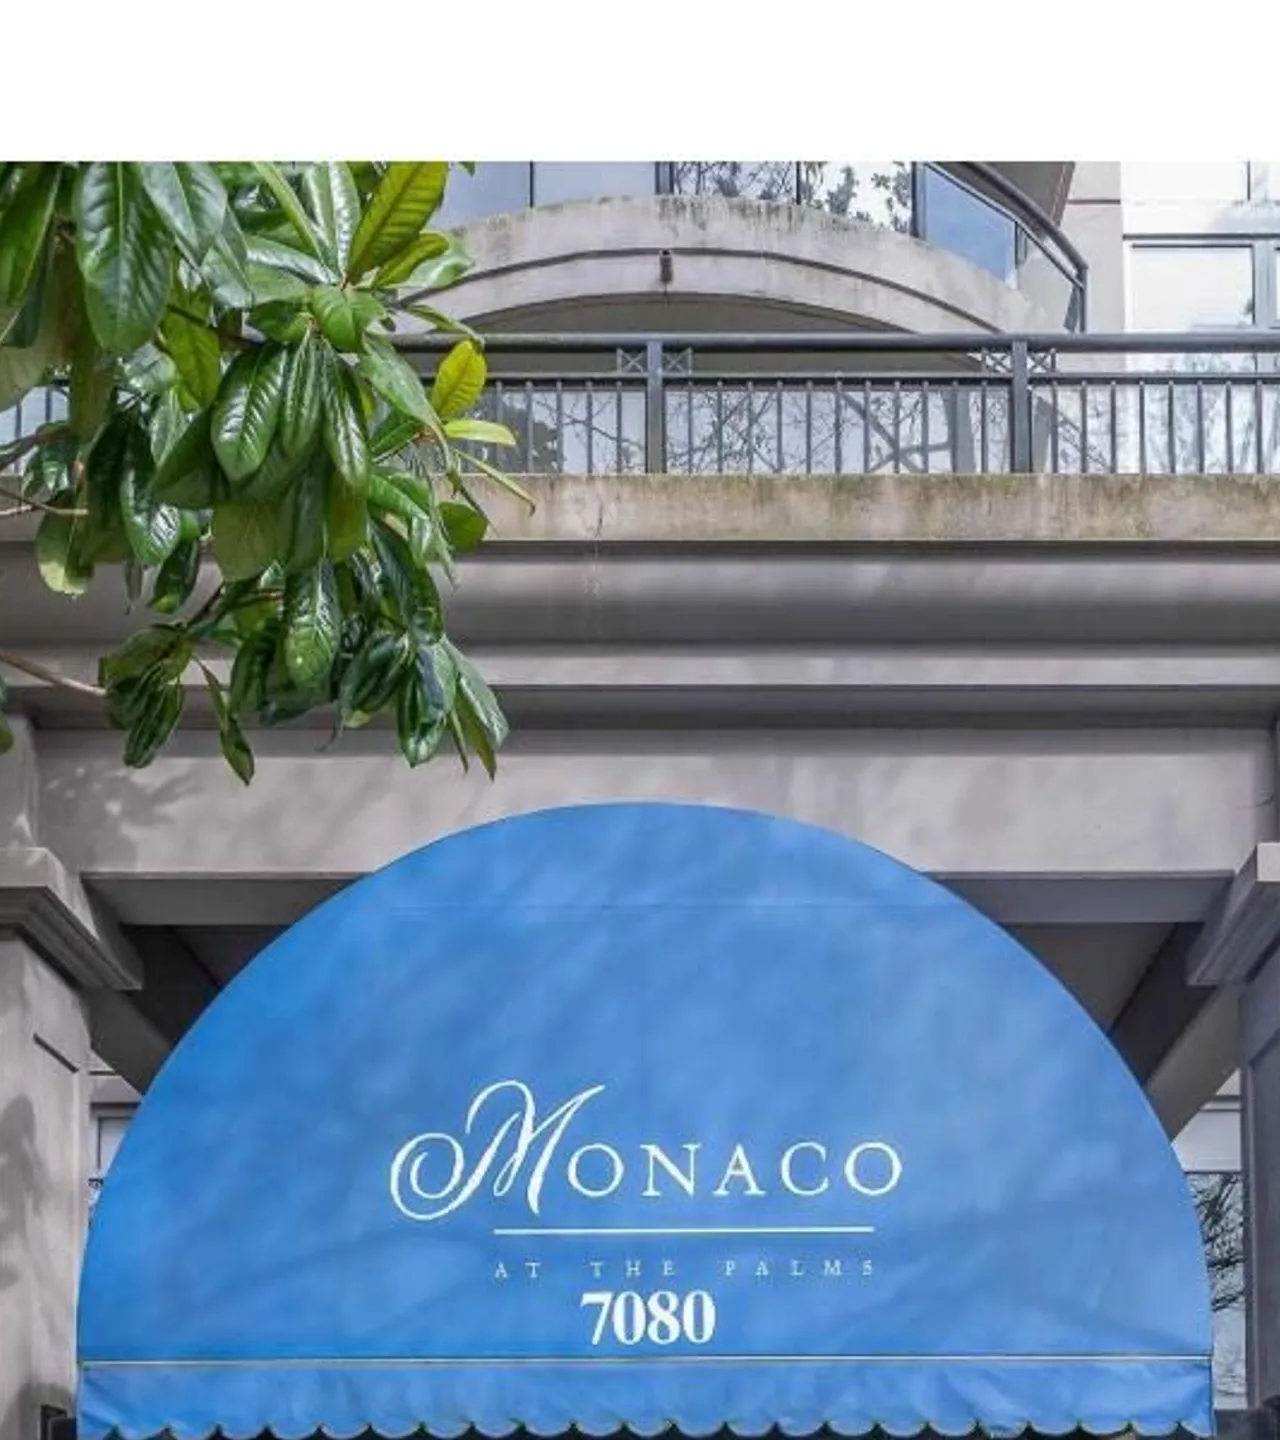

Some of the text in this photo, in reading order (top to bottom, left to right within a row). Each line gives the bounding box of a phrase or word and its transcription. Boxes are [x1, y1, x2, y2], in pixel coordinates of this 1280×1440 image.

[493, 1258, 873, 1280] AT THE PALMS
[580, 1289, 717, 1346] 7080
